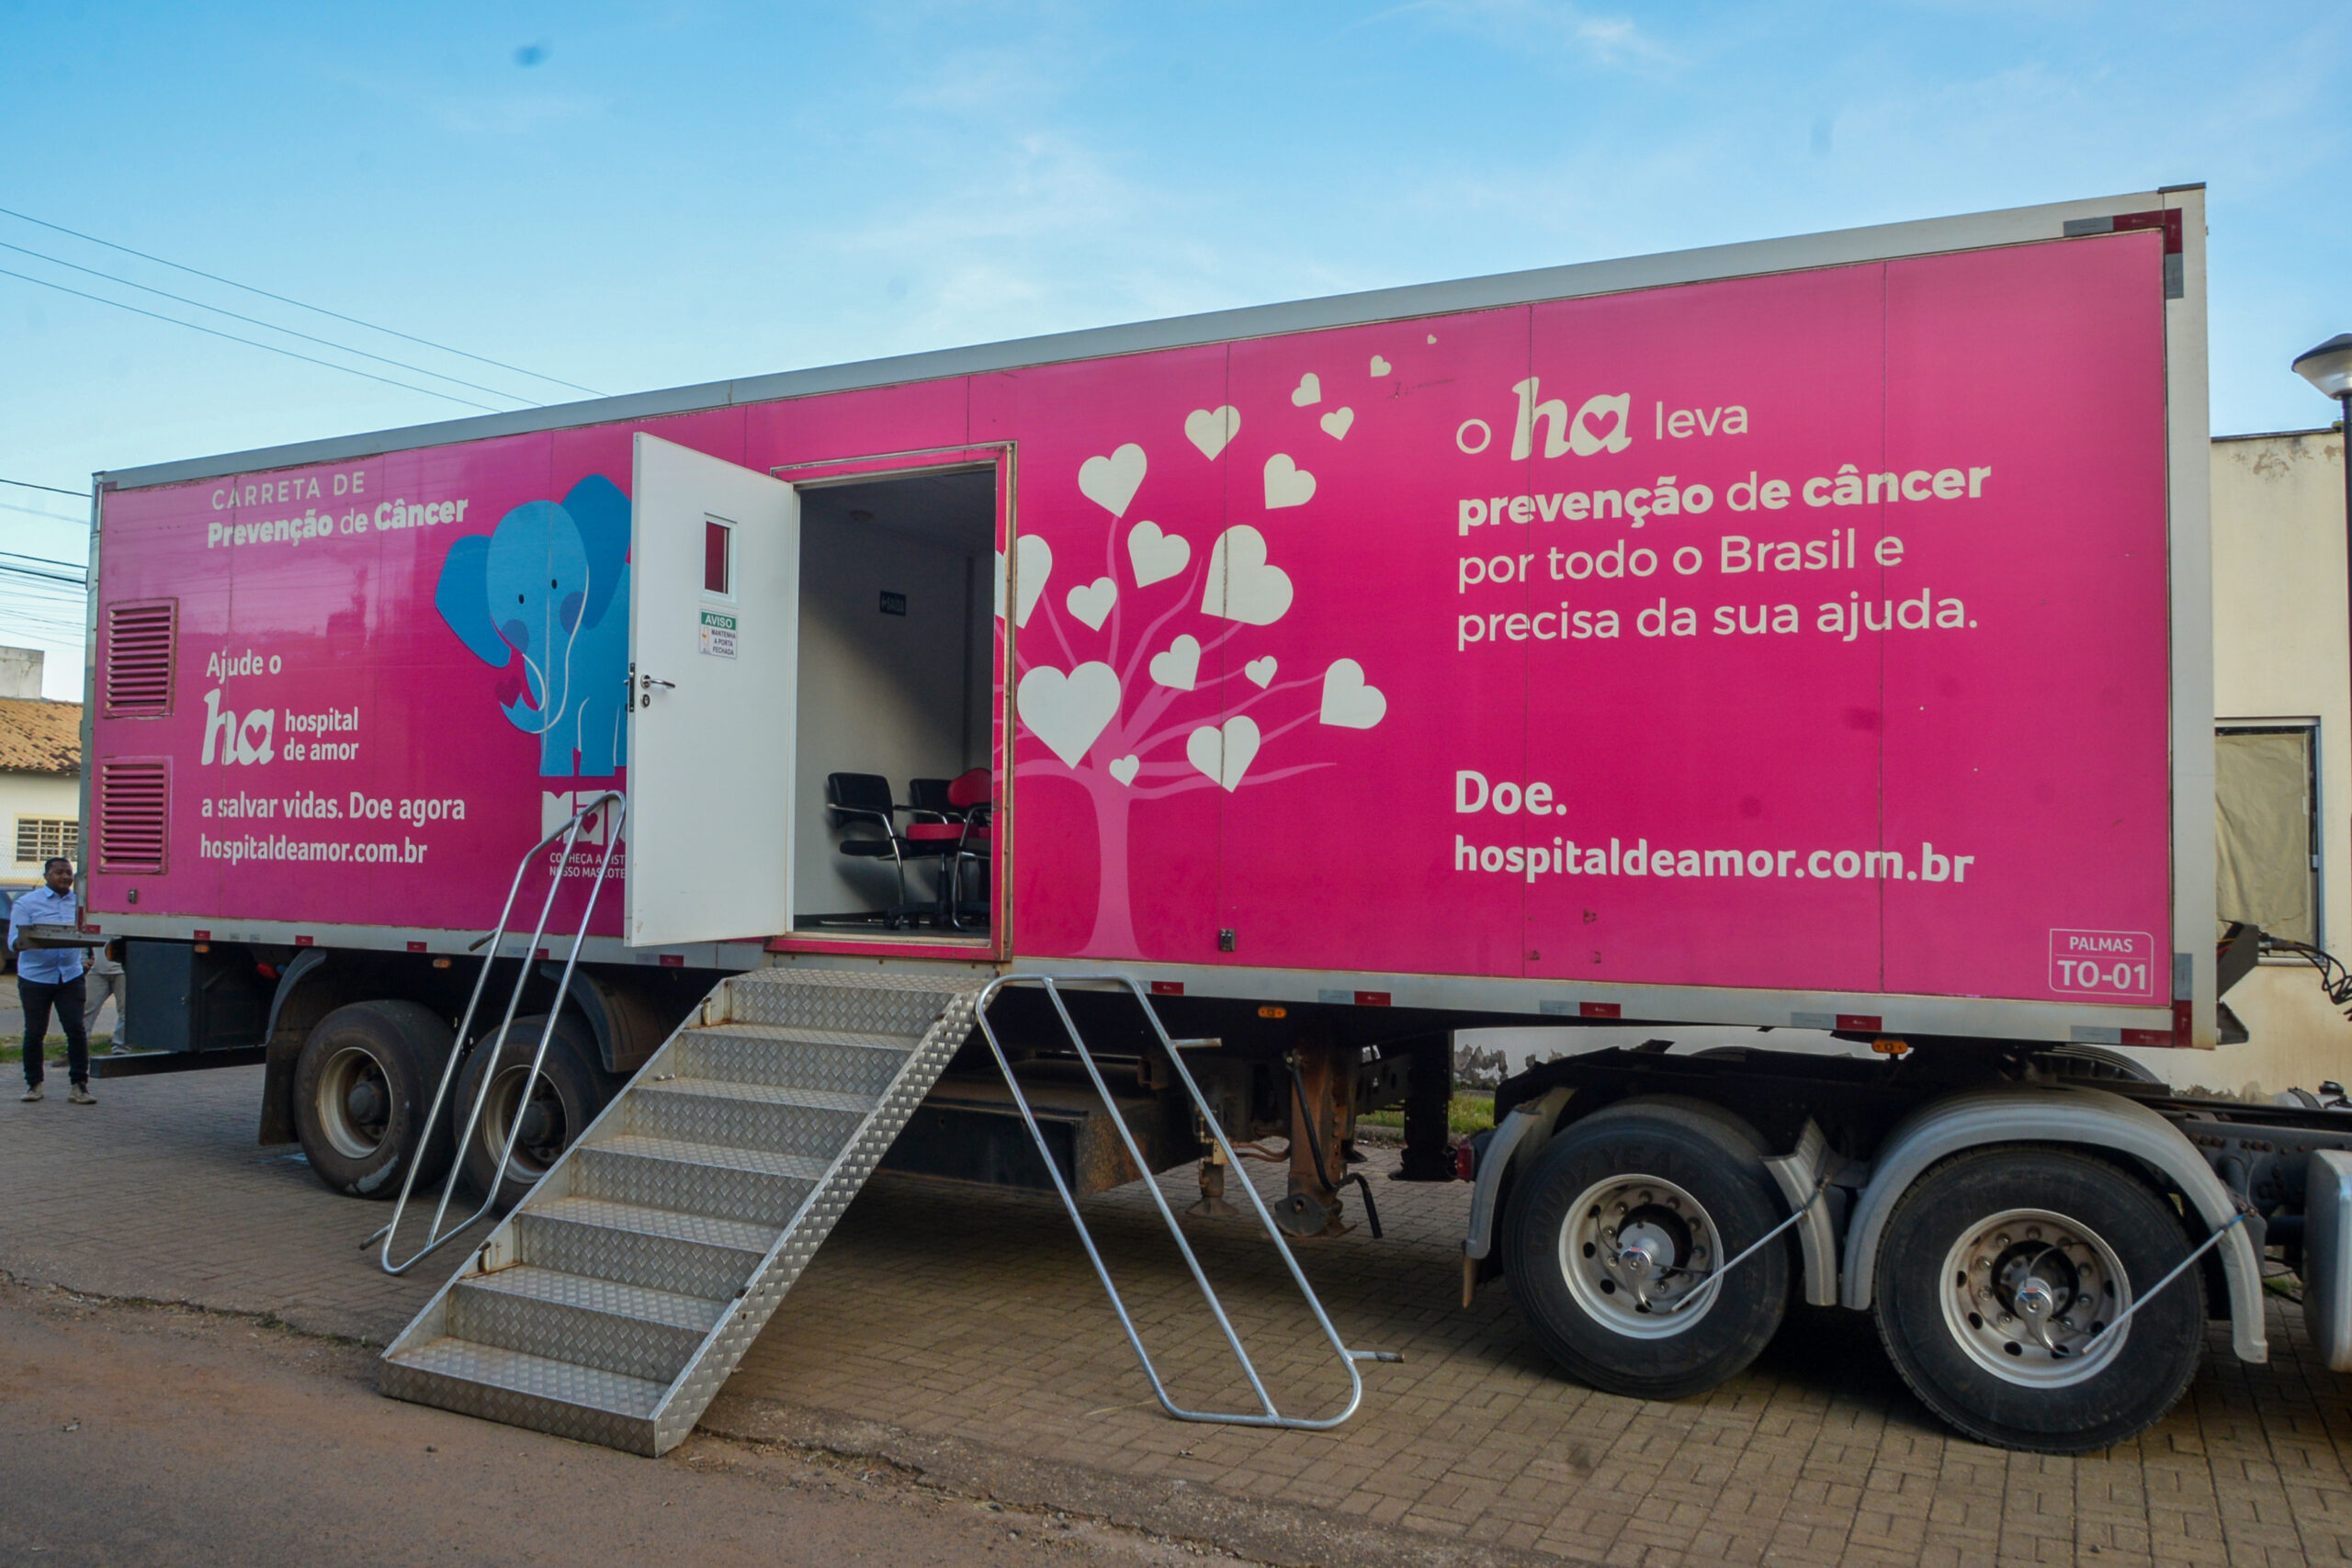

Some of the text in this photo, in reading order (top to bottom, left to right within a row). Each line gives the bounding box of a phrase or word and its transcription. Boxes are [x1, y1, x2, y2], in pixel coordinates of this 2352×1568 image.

[1510, 376, 1633, 461] ha
[1656, 400, 1748, 440] leva
[211, 470, 365, 510] CARRETA DE
[1458, 463, 1992, 536] prevenção de câncer
[207, 497, 469, 550] Prevenção de Câncer
[1458, 527, 1905, 594] por todo o Brasil e
[706, 615, 732, 627] AVISO
[711, 629, 735, 638] MANTENHA
[1458, 587, 1978, 652] precisa da sua ajuda.
[206, 649, 282, 684] Ajude o
[713, 646, 734, 655] FECHADA
[200, 688, 276, 766] ha
[283, 705, 360, 734] hospital
[283, 737, 360, 762] de amor
[201, 790, 465, 828] a salvar vidas. Doe agora
[1455, 770, 1567, 816] Doe.
[200, 832, 428, 866] hospitaldeamor.com.br
[549, 852, 593, 864] COHEÇA
[595, 853, 602, 864] A
[1454, 834, 1975, 884] hospitaldeamor.com.br
[549, 866, 626, 879] NSSO MASOTE
[2069, 936, 2133, 953] PALMAS
[2057, 960, 2145, 990] TO-01
